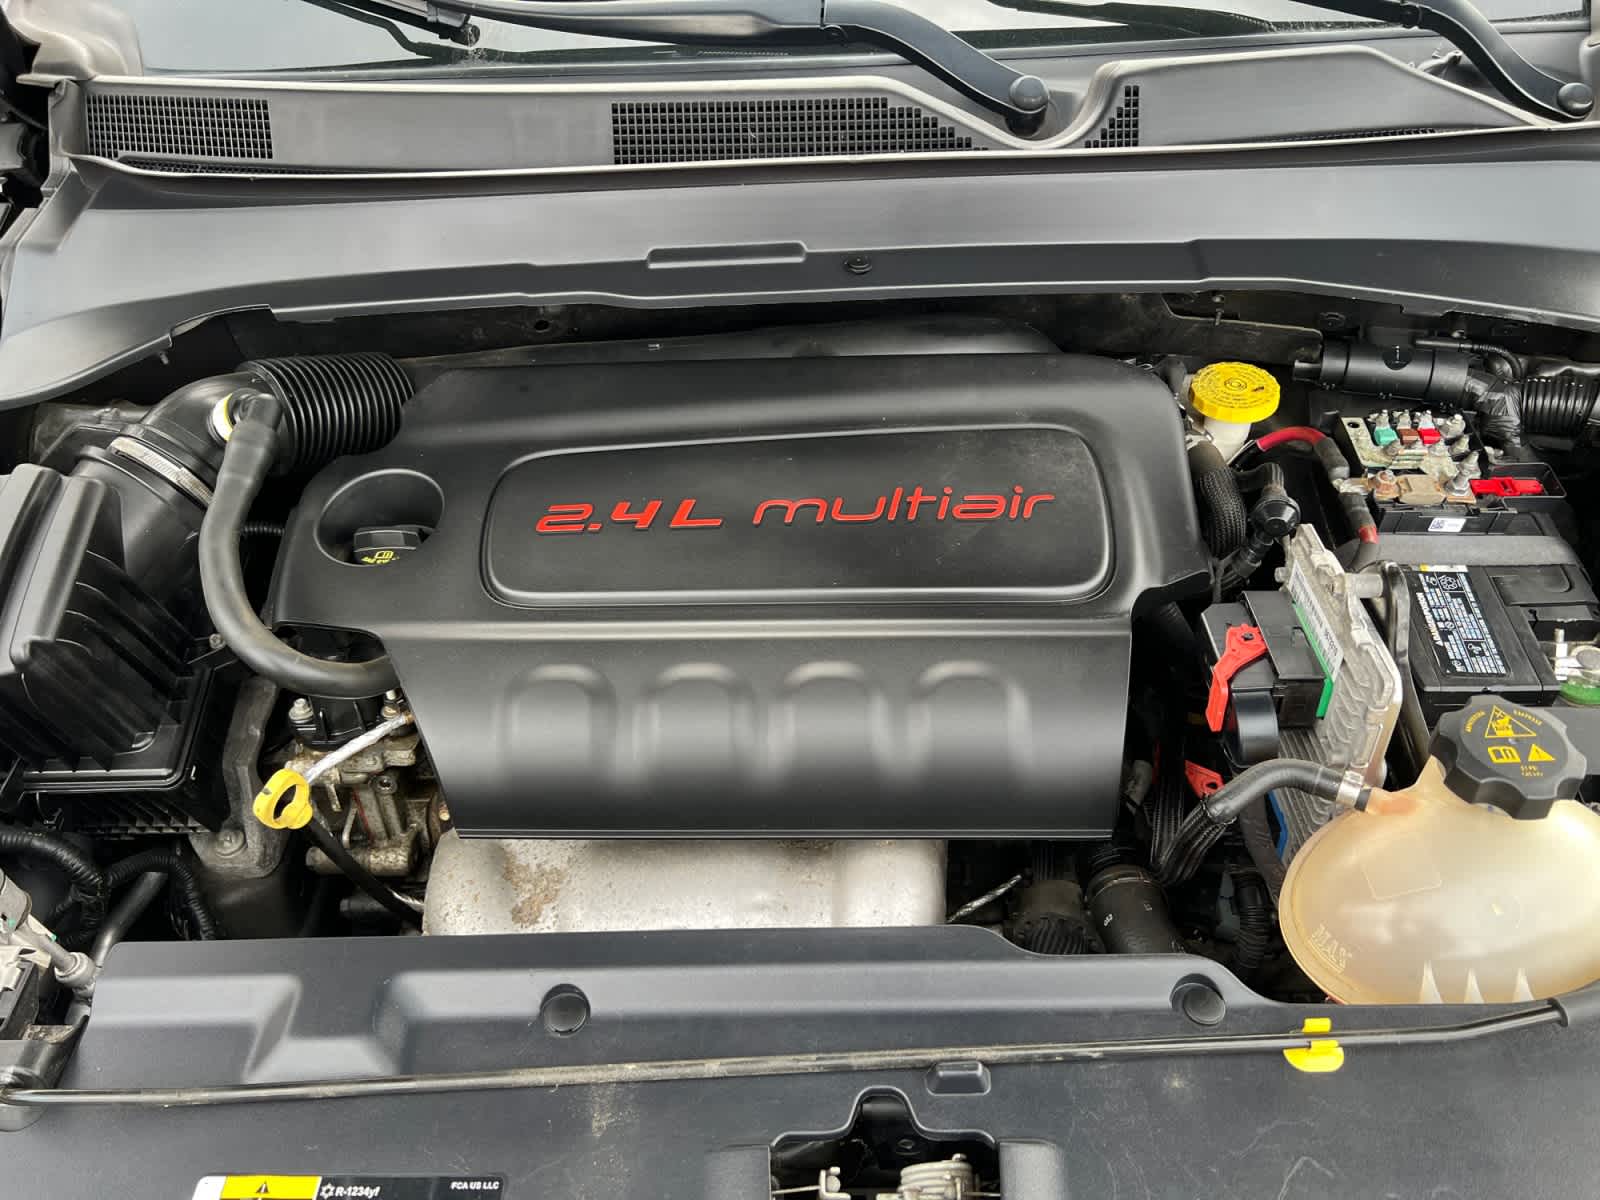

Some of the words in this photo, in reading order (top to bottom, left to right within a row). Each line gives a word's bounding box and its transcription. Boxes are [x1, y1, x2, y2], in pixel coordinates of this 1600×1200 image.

[752, 485, 1056, 525] multiair
[335, 1185, 381, 1199] R-1234yf
[451, 1181, 469, 1190] FCA
[469, 1181, 482, 1190] US
[483, 1181, 500, 1190] LLC
